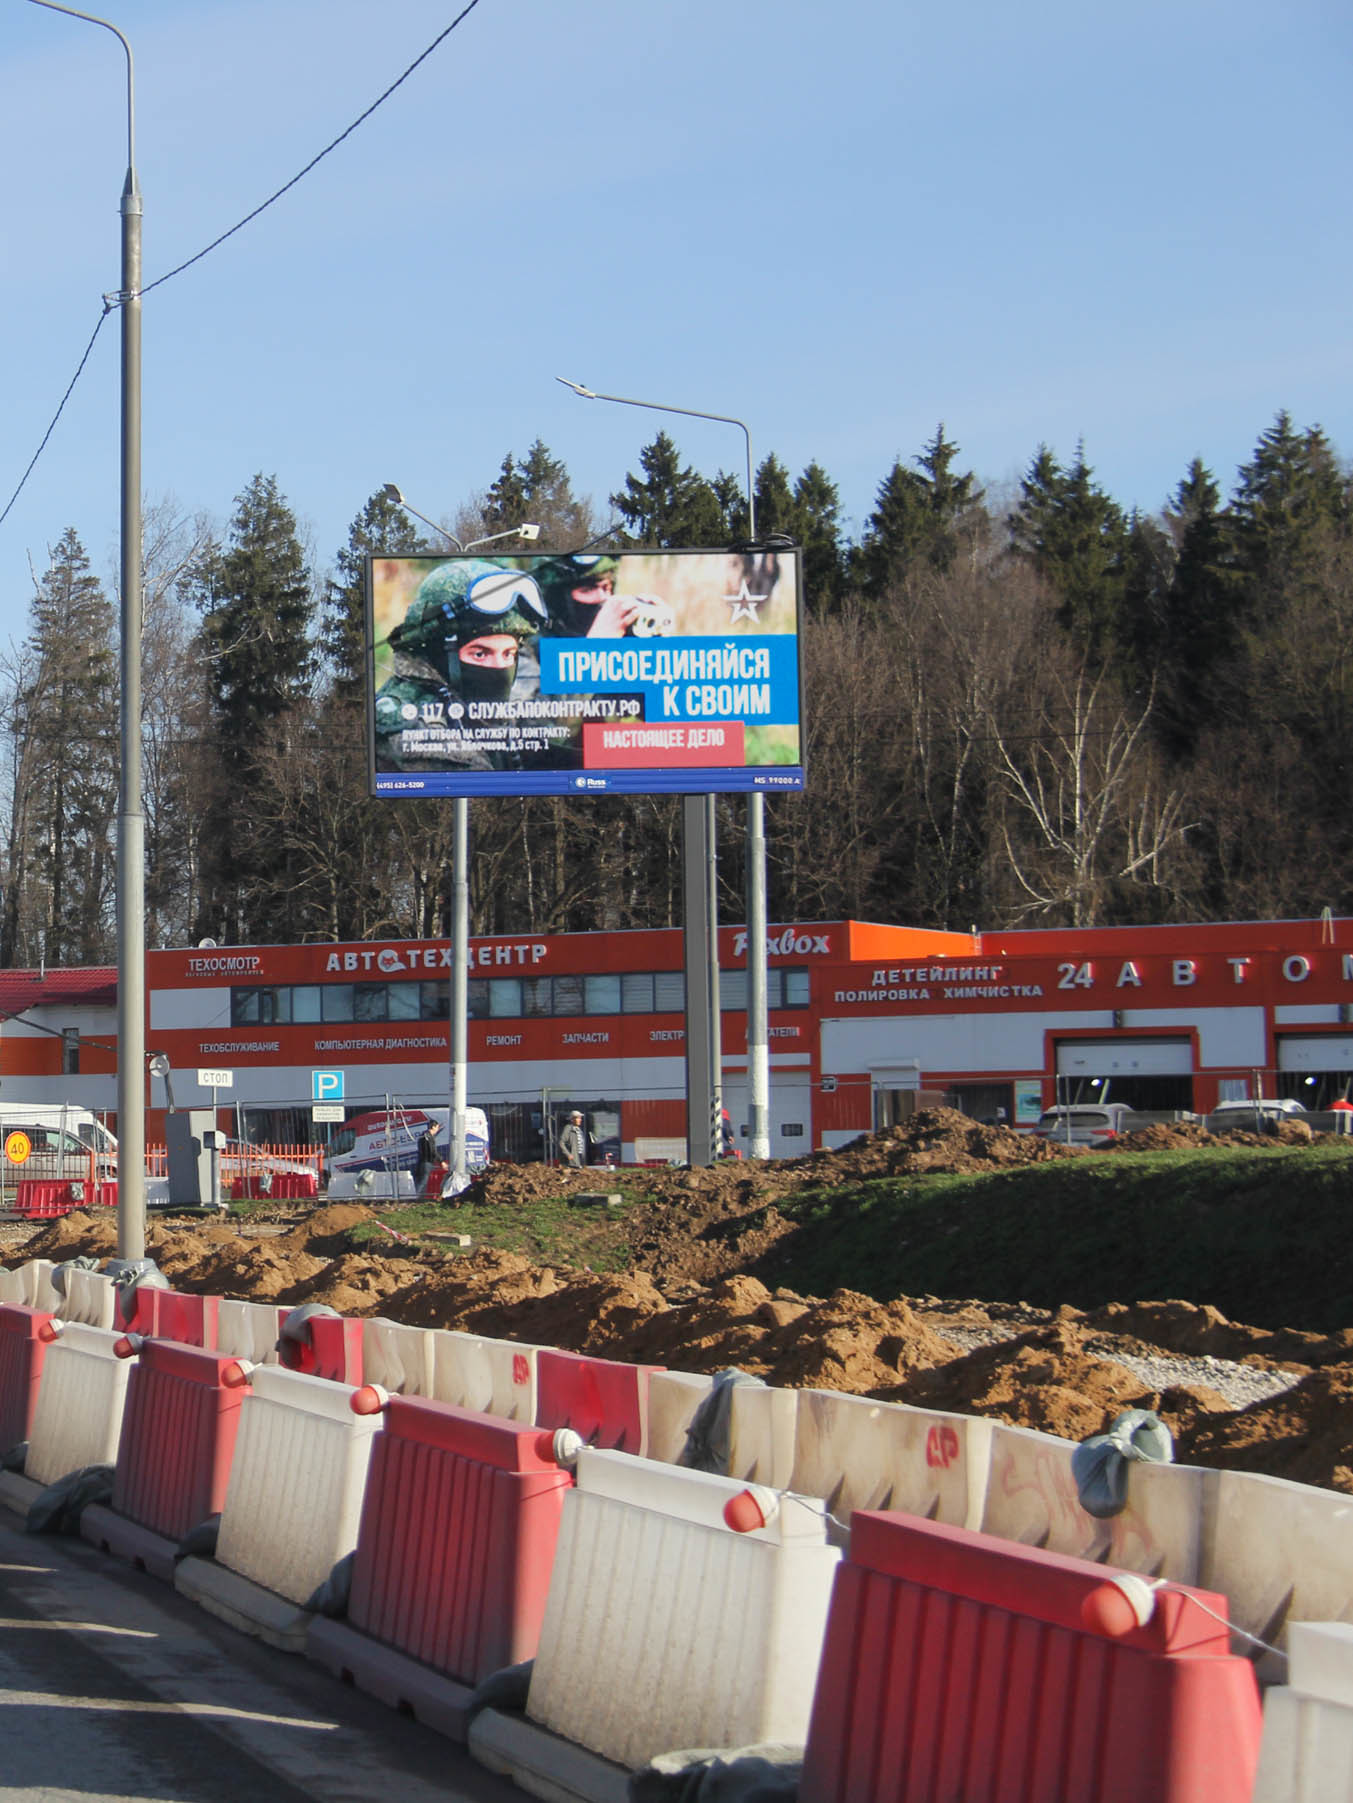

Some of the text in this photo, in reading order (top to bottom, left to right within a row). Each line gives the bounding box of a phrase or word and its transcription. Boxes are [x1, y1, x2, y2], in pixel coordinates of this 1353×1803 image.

[559, 643, 770, 684] ПРИСОЕДИНЯЙСЯ
[663, 683, 771, 716] К СВОИМ
[422, 700, 641, 720] 117 СЛУЖБАПОКОНТРАКТУ.РФ
[402, 726, 571, 741] ПУНКТ ОТБОРА НА СЛУЖБУ ПО КОНТРАКТУ:
[603, 728, 725, 749] НАСТОЯЩЕЕ ДЕЛО
[732, 928, 830, 957] Fxbox
[189, 956, 260, 972] ТЕХОСМОТР
[872, 966, 1002, 987] ДЕТЕЙЛИНГ
[1057, 961, 1095, 989] 24
[834, 985, 1043, 1003] ПОЛИРОВКА ХИМЧИСТКА
[314, 1037, 447, 1051] КОМПЬЮТЕРНАЯ ДИАГНОСТИКА
[486, 1035, 522, 1047] РЕМОНТ
[562, 1032, 609, 1045] ЗАПЧАСТИ
[650, 1030, 686, 1042] ЭЛЕКТР
[199, 1041, 280, 1054] ТЕХОБСЛУЖИВАНИЕ
[203, 1072, 228, 1084] СТОП
[318, 1073, 339, 1100] P
[11, 1142, 25, 1154] 40
